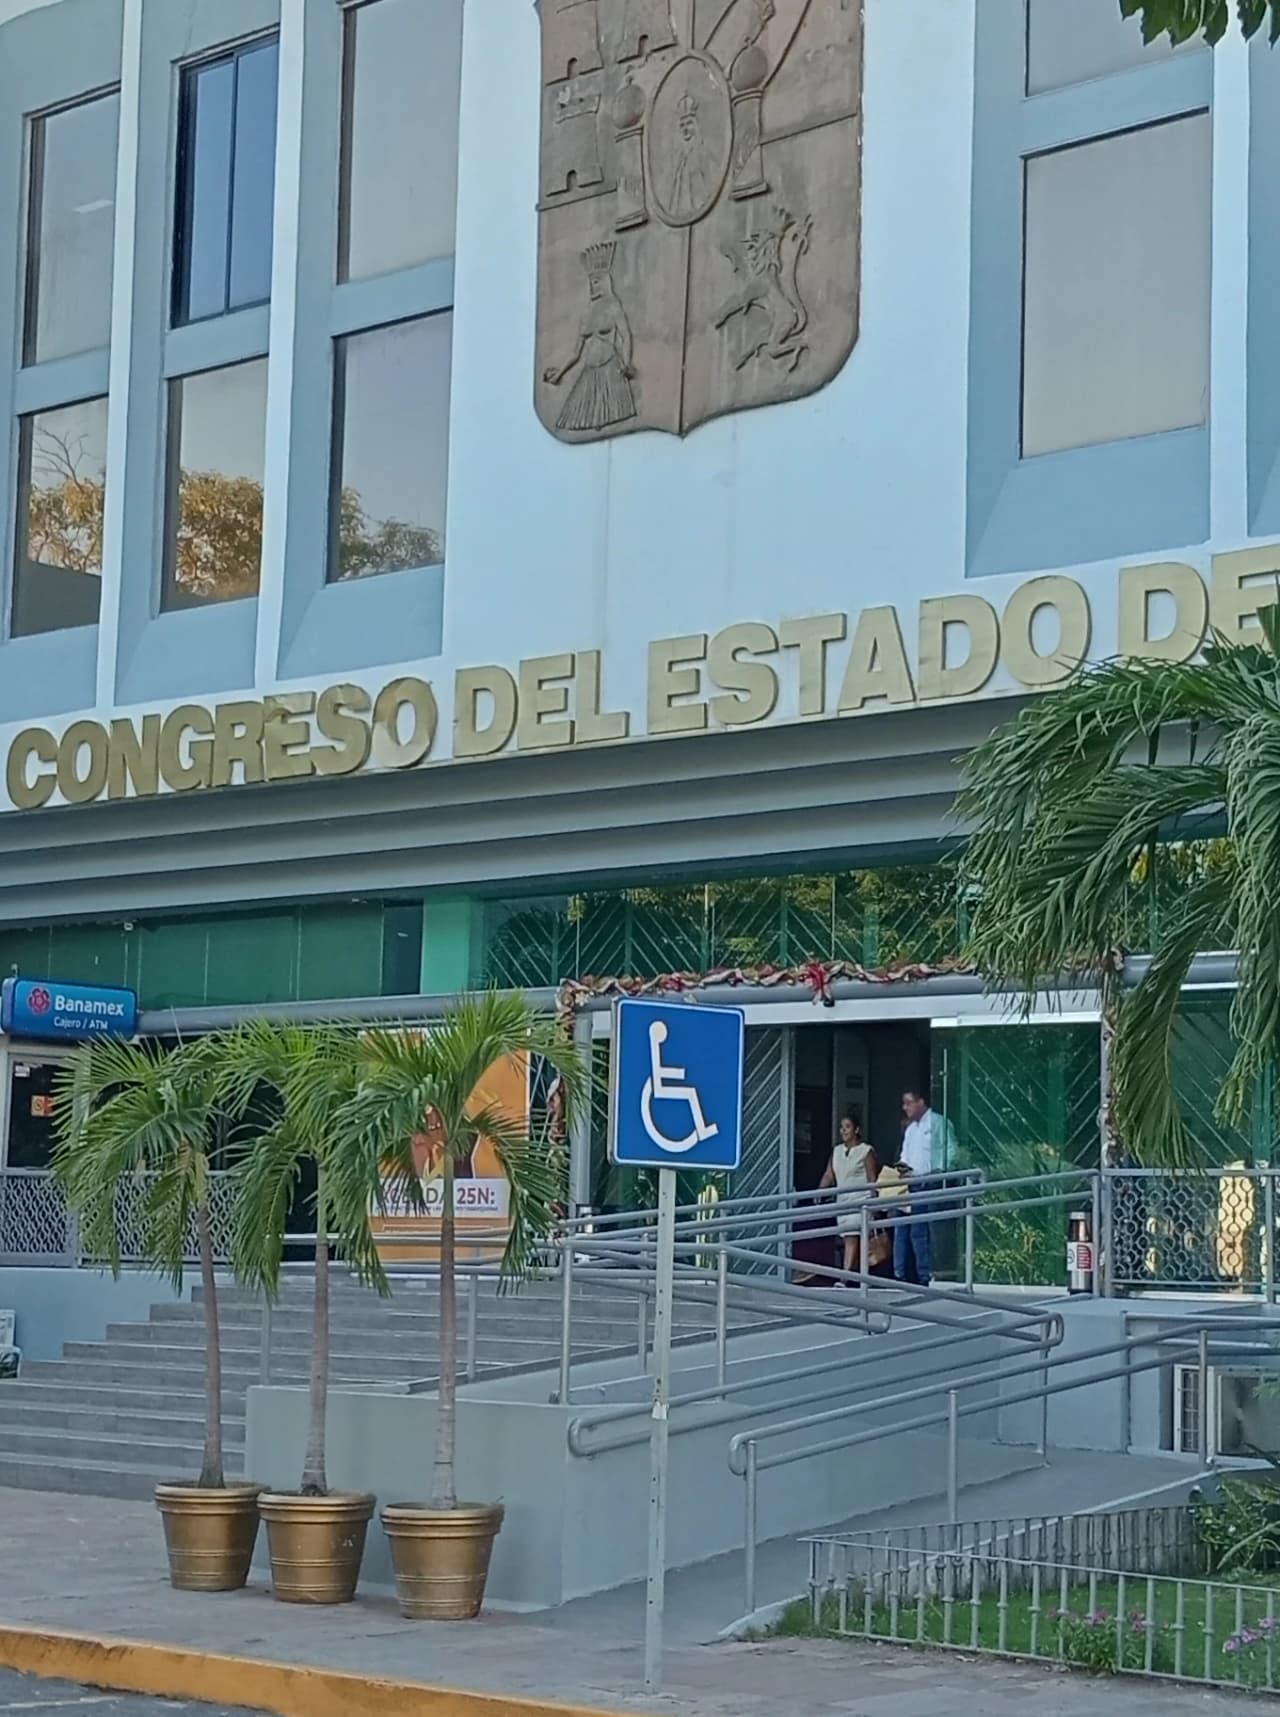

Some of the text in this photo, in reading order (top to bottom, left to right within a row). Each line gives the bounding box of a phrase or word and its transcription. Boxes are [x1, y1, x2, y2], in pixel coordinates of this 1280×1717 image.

[6, 676, 438, 810] CONGRESO
[453, 650, 629, 759] DEL
[647, 574, 1091, 734] ESTADO
[54, 995, 124, 1016] Banamex
[54, 1016, 81, 1029] Cajero
[88, 1019, 108, 1030] ATM
[456, 1187, 495, 1205] 25N:
